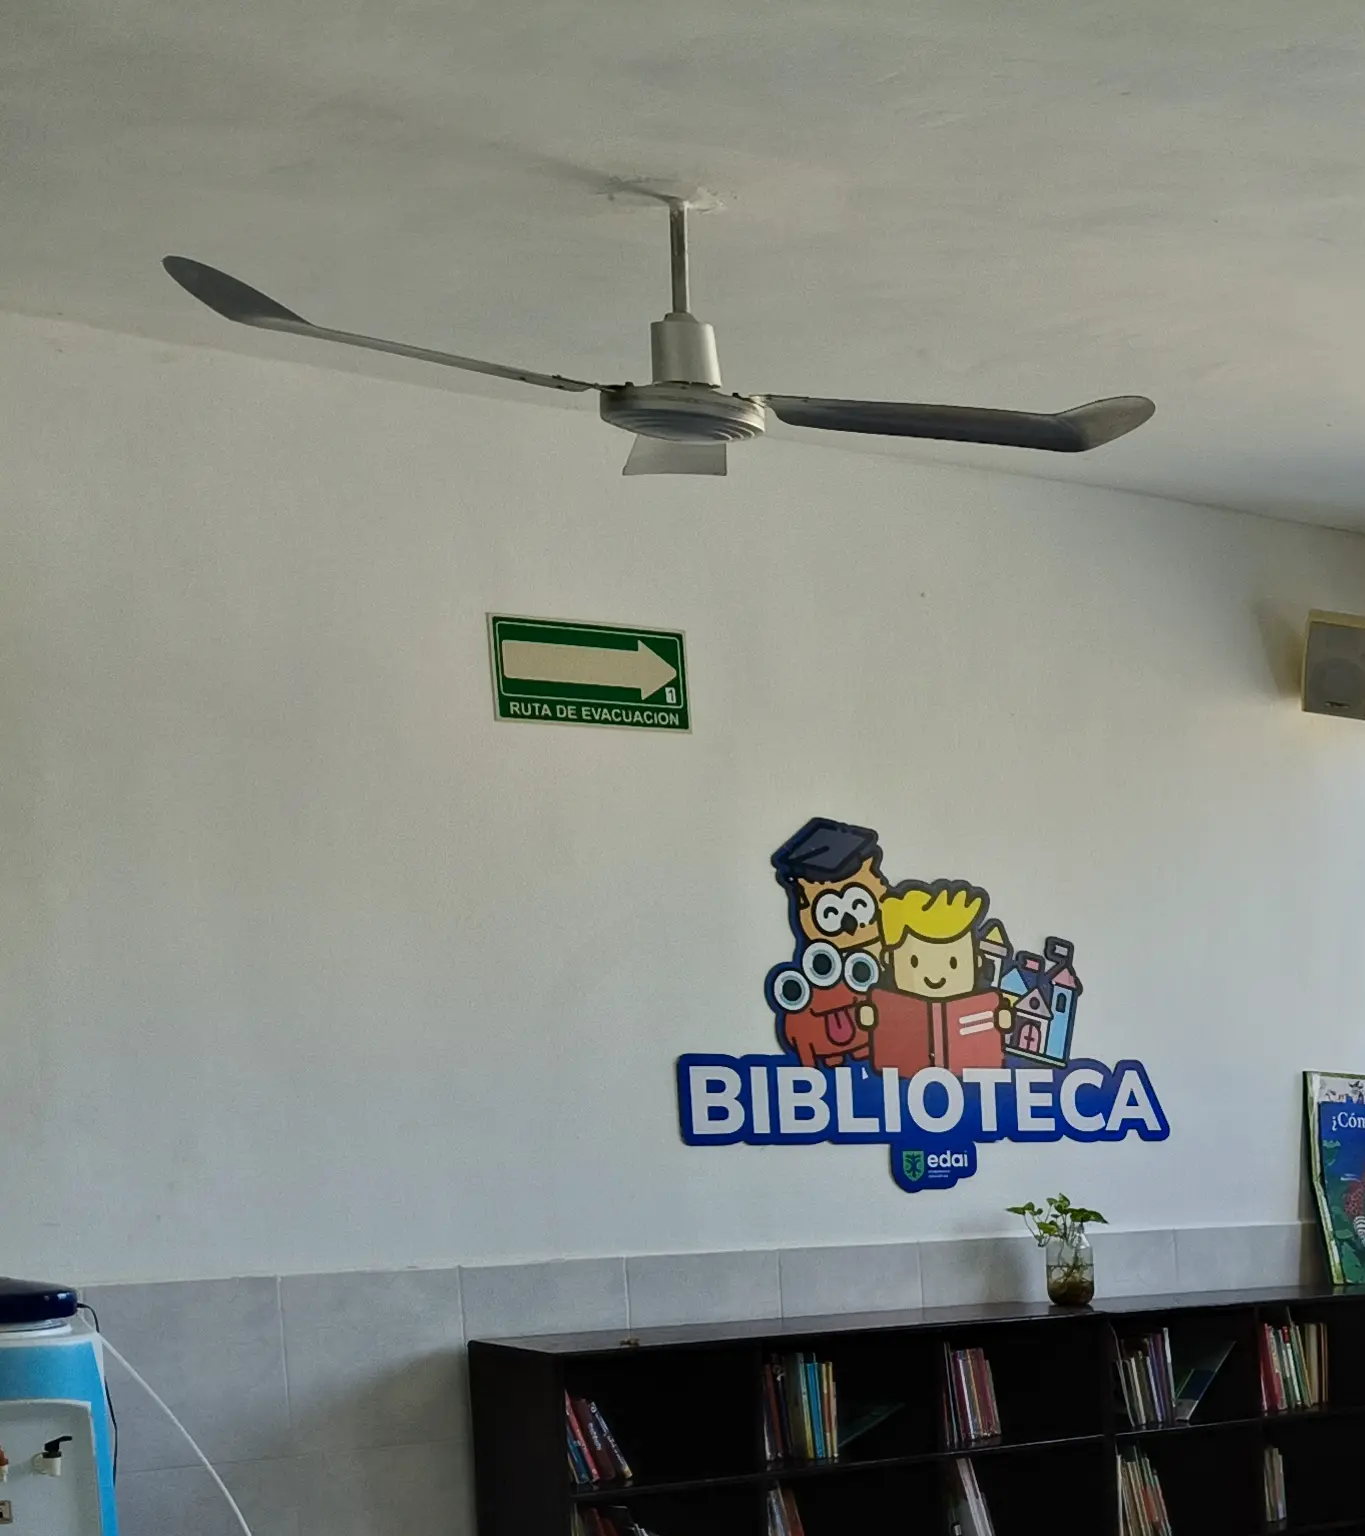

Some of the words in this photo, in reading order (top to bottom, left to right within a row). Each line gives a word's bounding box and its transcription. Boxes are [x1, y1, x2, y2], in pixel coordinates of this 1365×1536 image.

[509, 701, 552, 717] RUTA
[556, 704, 577, 719] DE
[581, 706, 680, 726] EVACUACION
[689, 1065, 1162, 1135] BIBLIOTECA
[927, 1149, 969, 1168] edai
